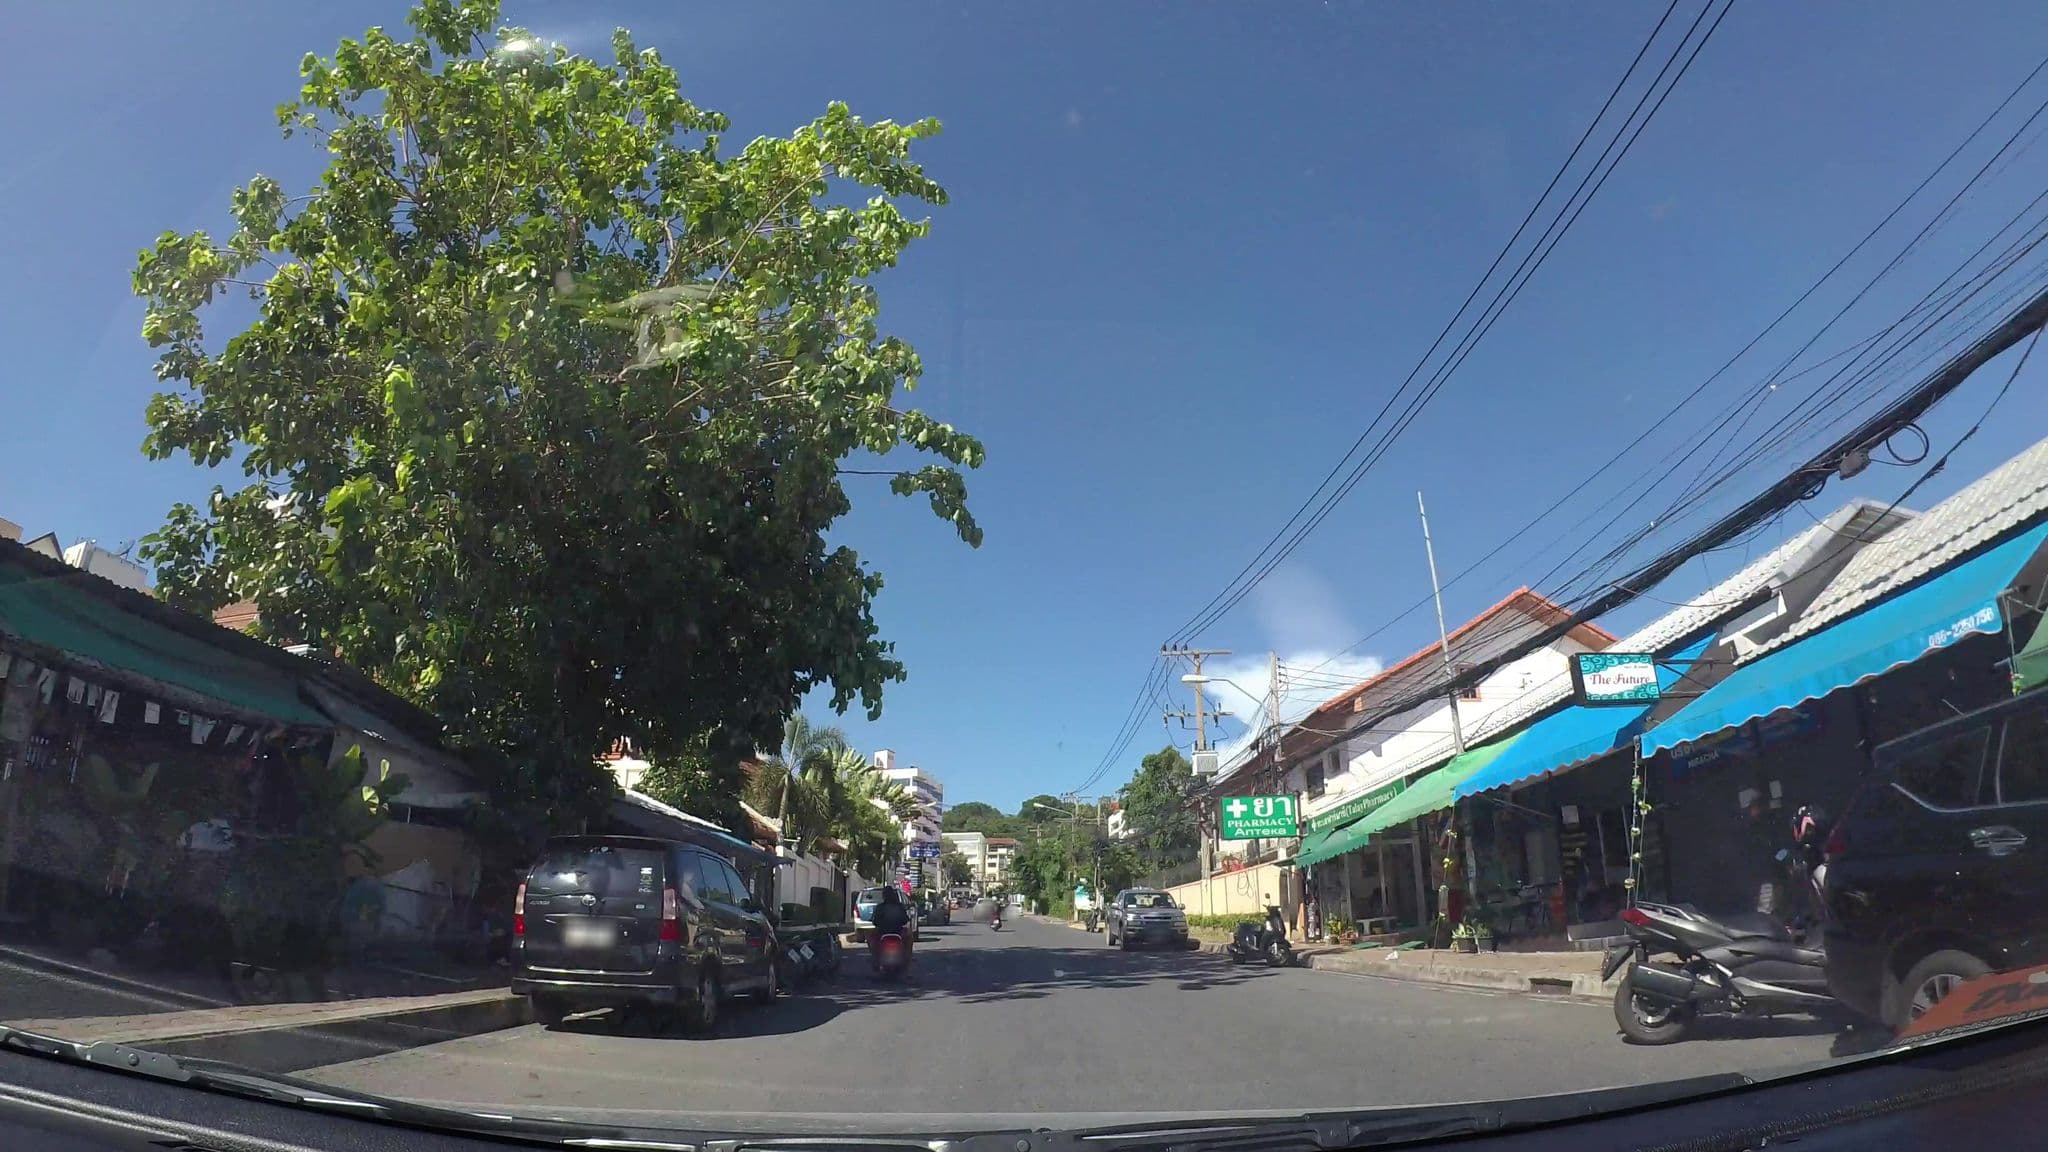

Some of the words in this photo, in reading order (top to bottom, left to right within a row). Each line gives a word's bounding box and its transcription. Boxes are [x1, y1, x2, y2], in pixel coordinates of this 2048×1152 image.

[1590, 674, 1611, 685] The
[1613, 673, 1650, 685] Future
[1253, 797, 1292, 818] ยา
[1227, 817, 1294, 829] PHARMACY
